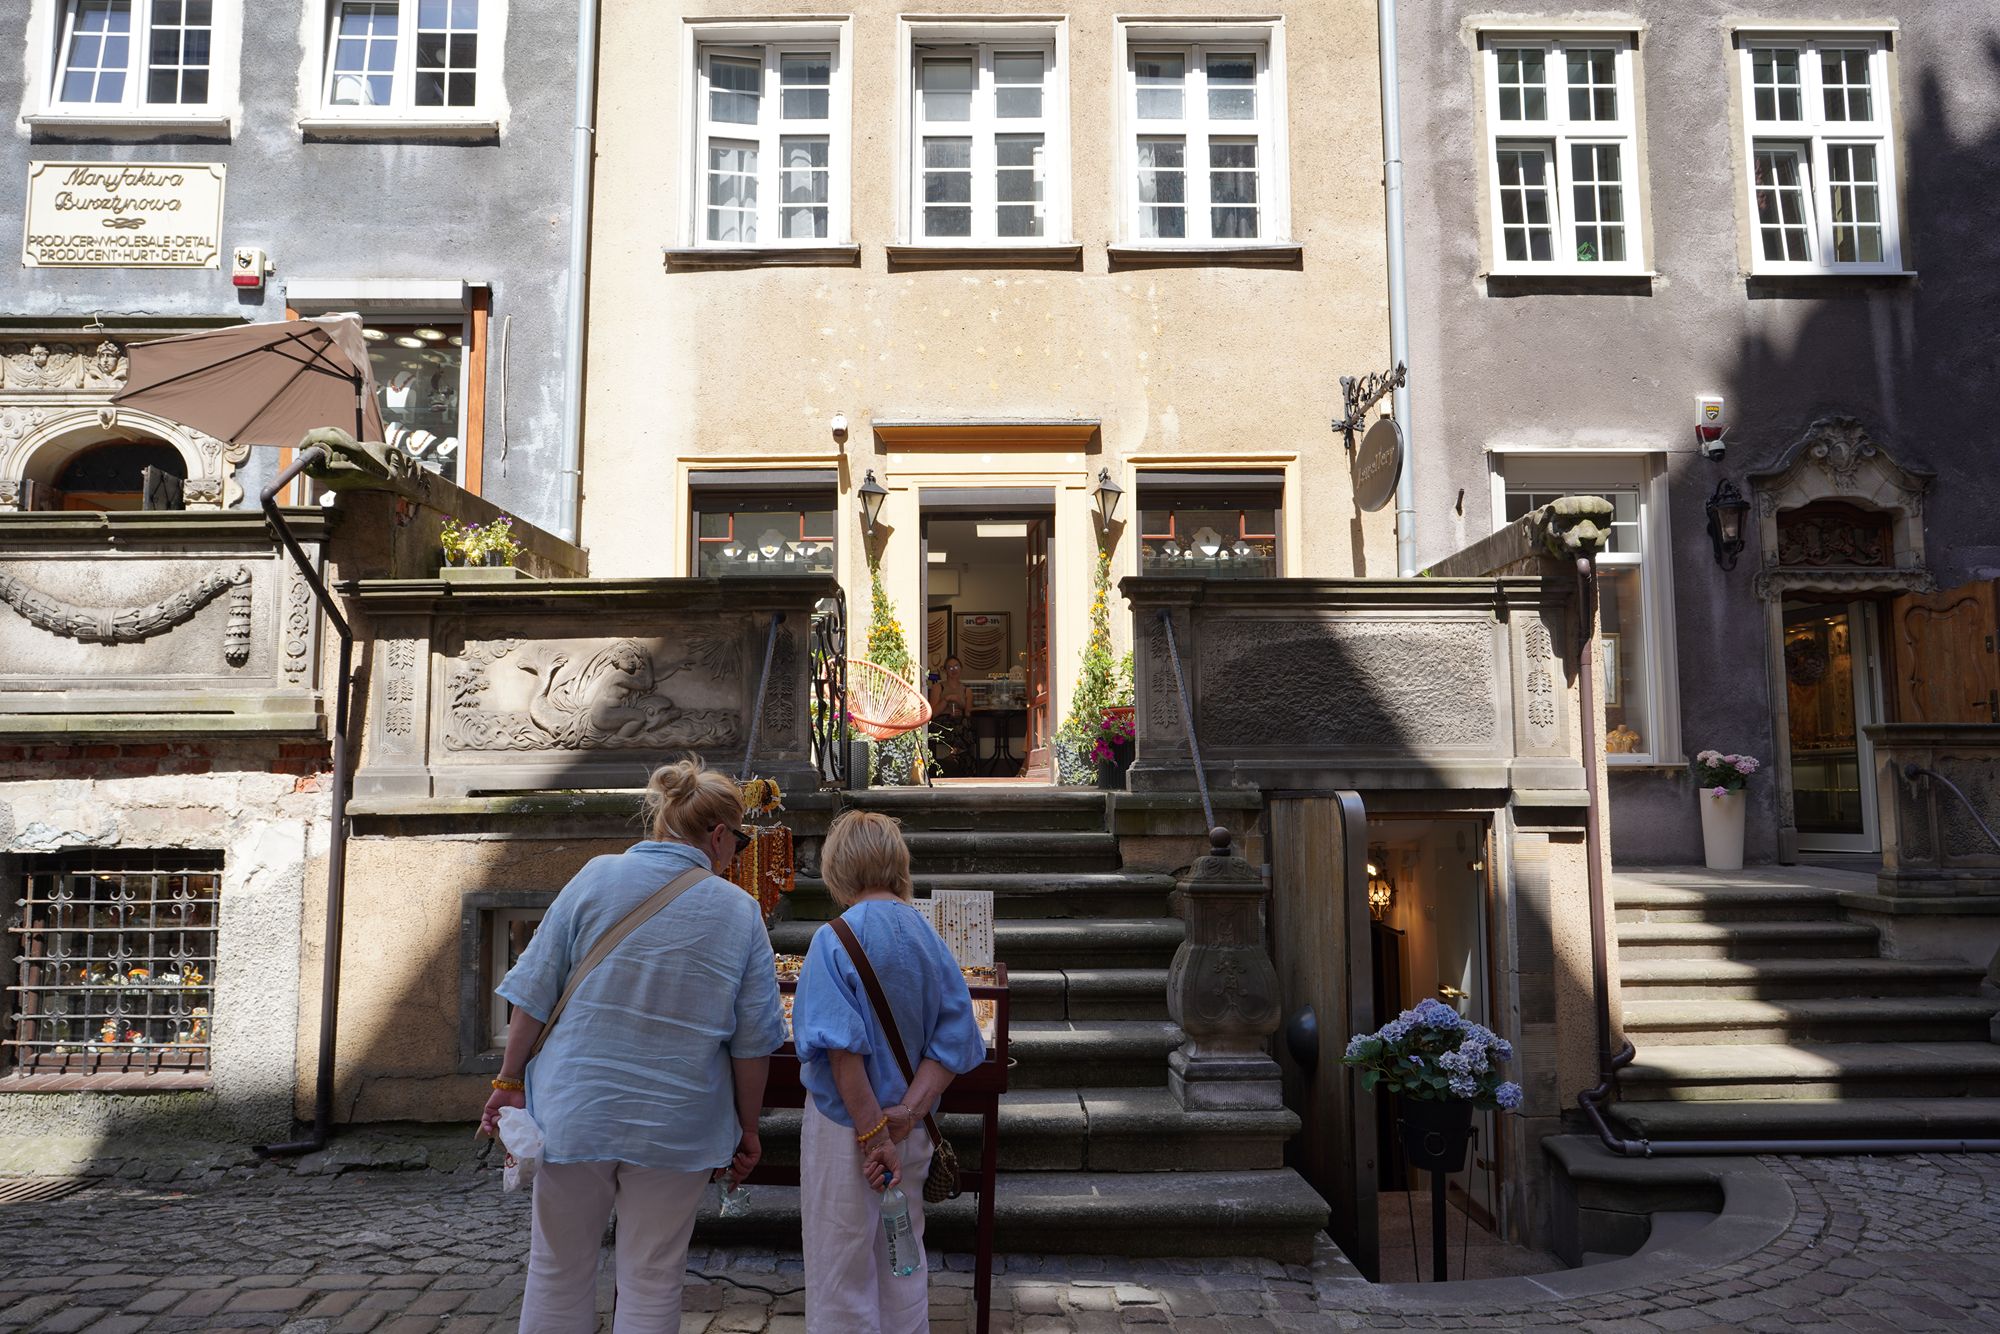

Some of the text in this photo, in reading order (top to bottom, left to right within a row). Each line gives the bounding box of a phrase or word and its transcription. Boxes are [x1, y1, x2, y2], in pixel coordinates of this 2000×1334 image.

[62, 167, 184, 192] Manufaktura
[54, 191, 182, 214] Bursztynowa
[40, 248, 203, 262] PRODUCENT HURT DETAL
